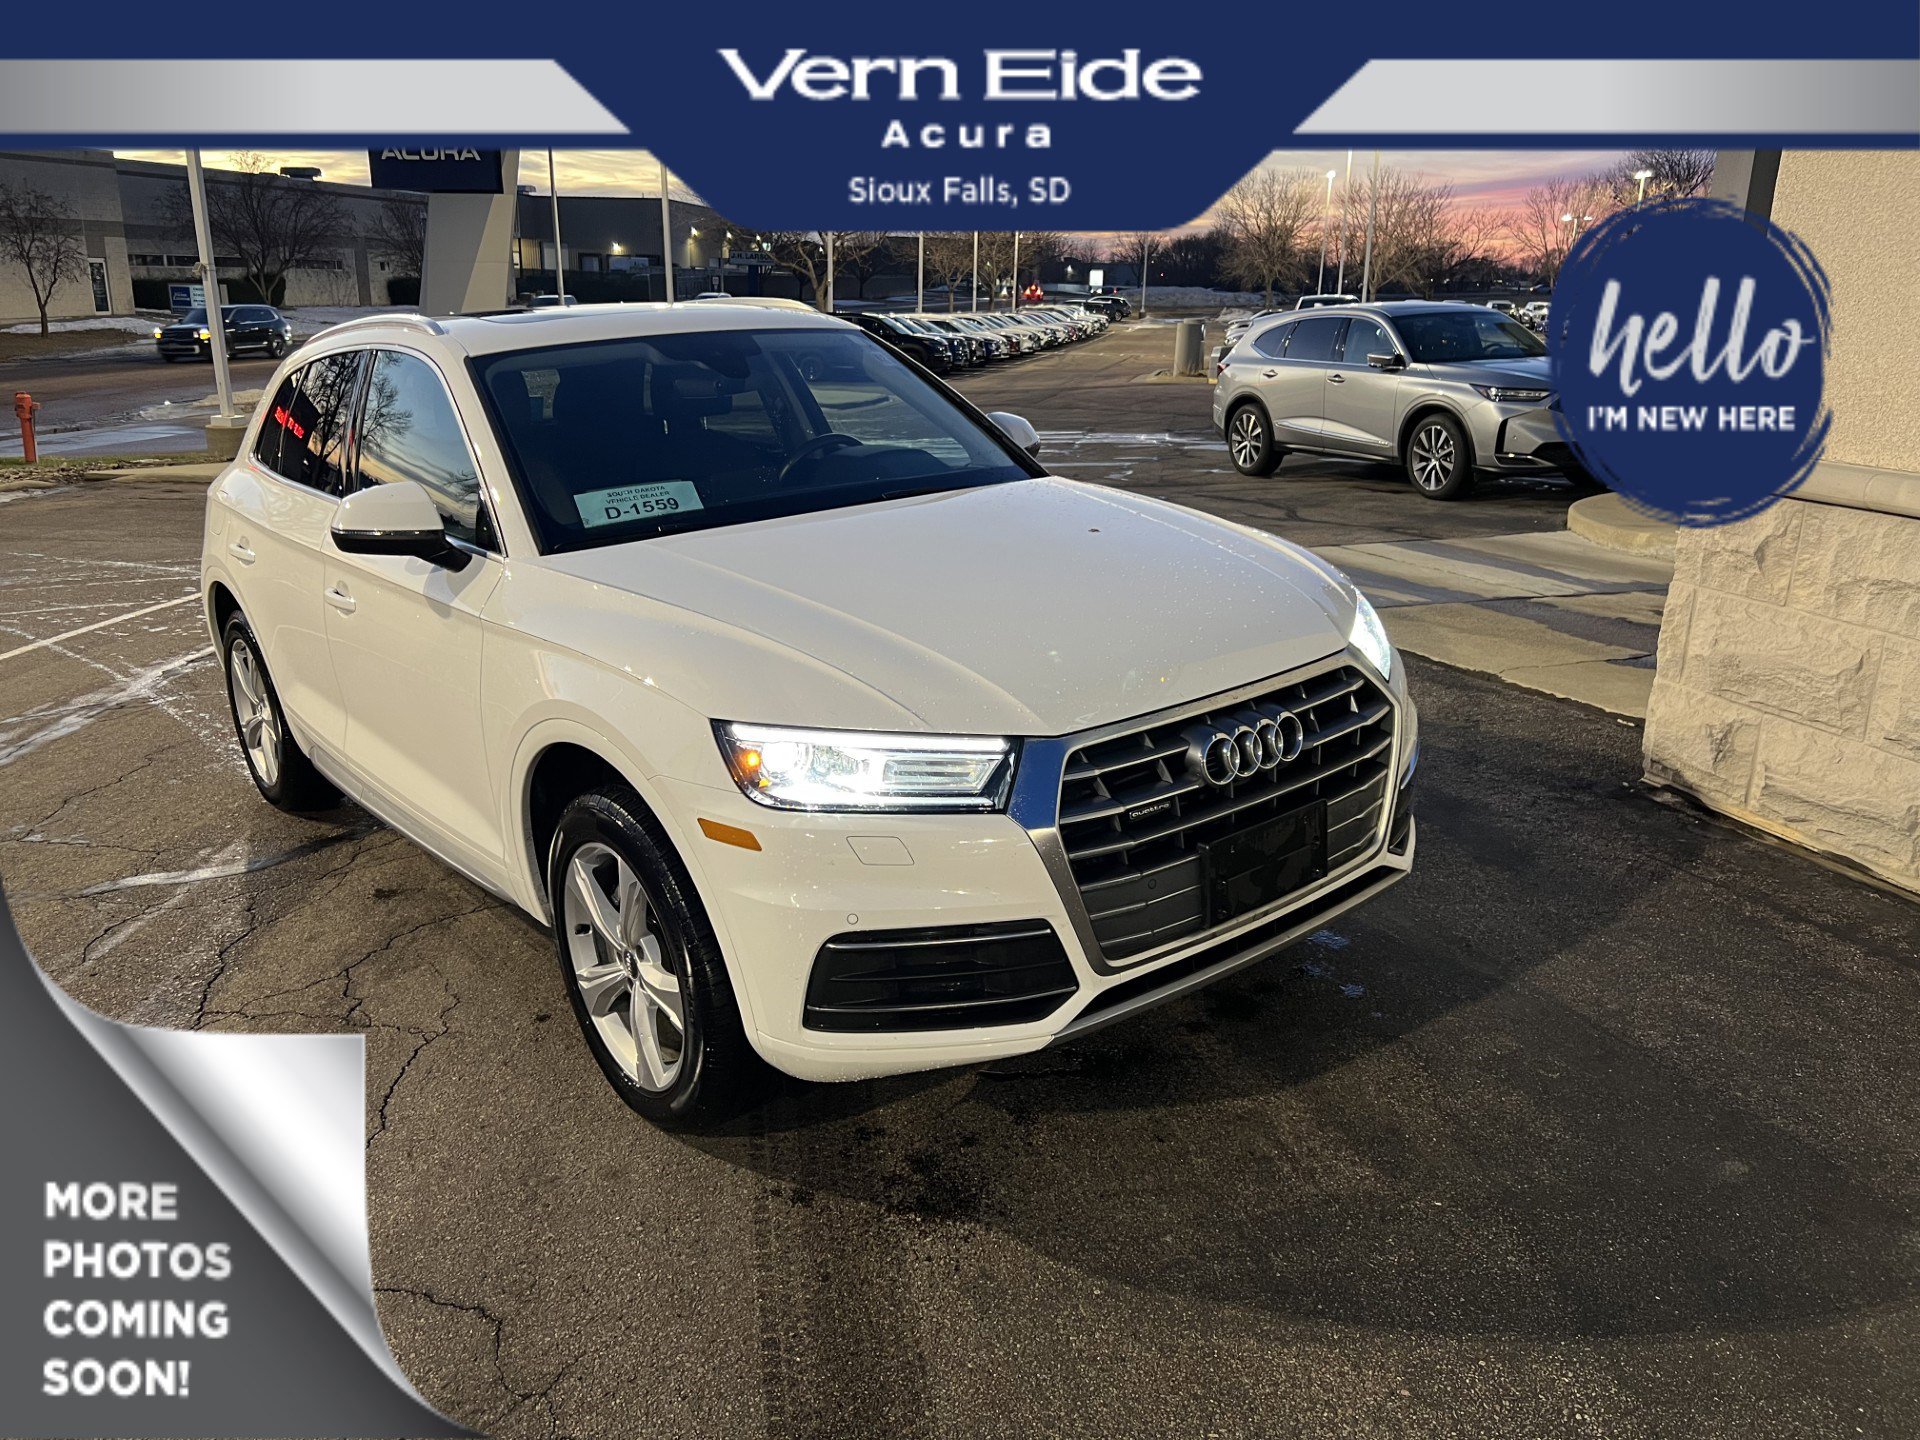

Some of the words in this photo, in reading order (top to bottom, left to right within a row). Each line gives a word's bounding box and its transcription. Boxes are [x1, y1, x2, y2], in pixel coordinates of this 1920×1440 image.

[381, 146, 481, 161] ACURA
[605, 495, 638, 505] VEHICLE
[639, 490, 670, 500] DEALER
[606, 489, 634, 498] SOUTH
[634, 485, 666, 495] DAKOTA
[604, 497, 680, 520] D-1559
